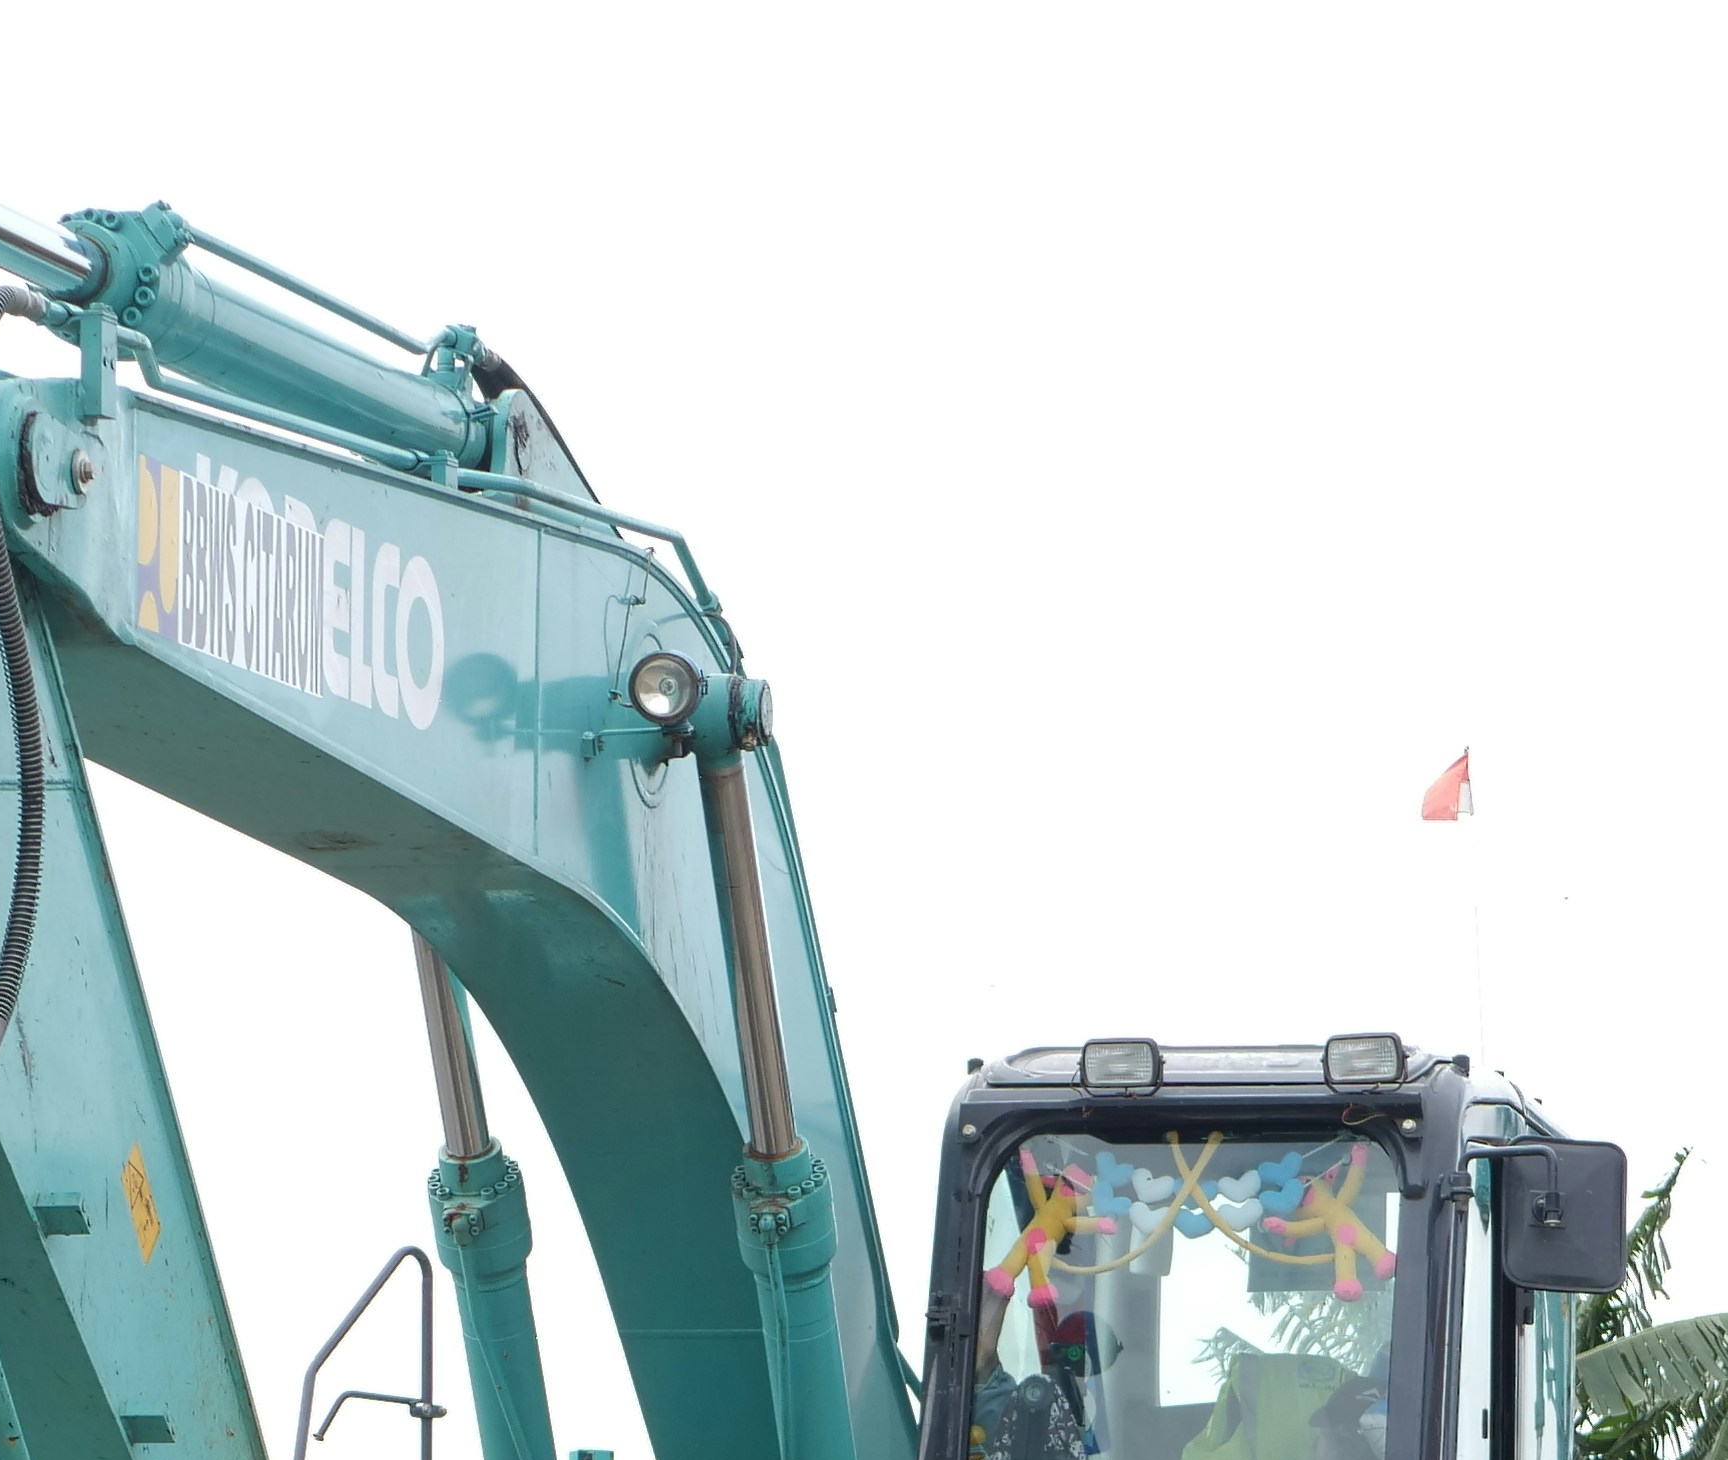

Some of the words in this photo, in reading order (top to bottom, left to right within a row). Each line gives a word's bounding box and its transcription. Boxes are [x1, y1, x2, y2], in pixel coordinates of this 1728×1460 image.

[181, 475, 237, 664] BBWS
[243, 502, 325, 697] CITARUM
[196, 453, 444, 730] ELCO
